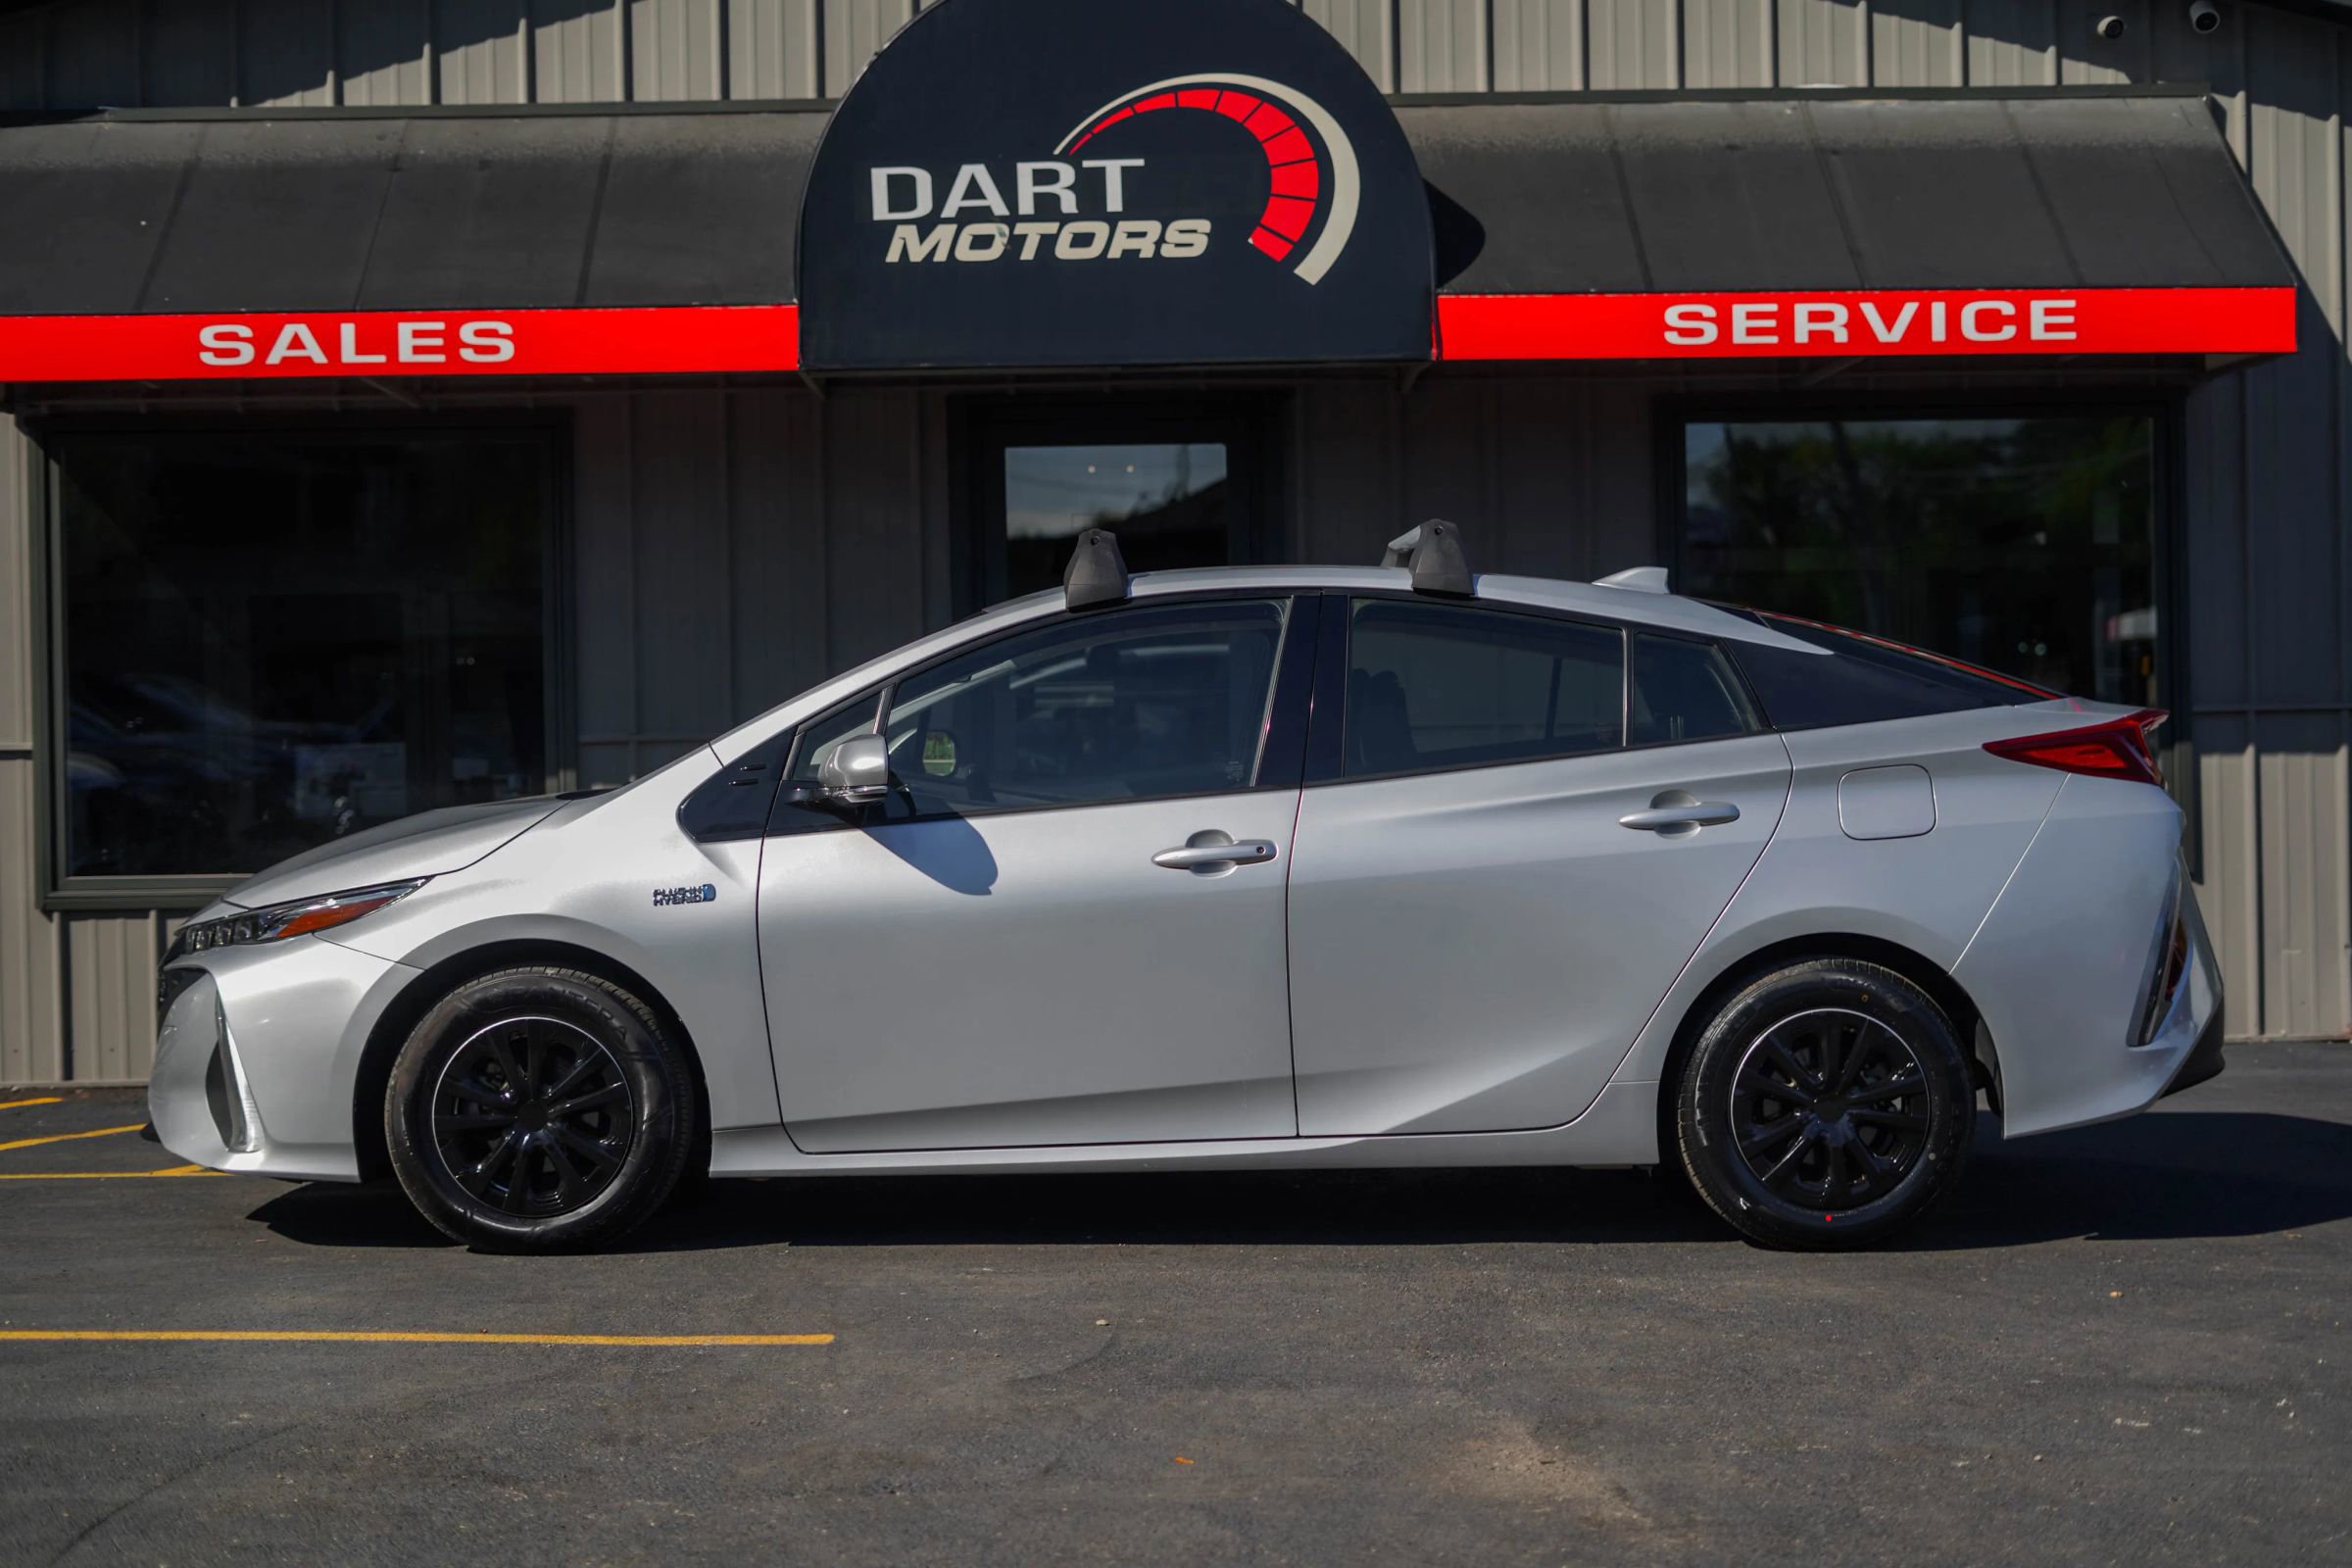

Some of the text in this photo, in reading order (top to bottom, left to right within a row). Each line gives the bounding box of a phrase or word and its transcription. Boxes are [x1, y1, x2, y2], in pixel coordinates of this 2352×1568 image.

[870, 159, 1145, 220] DART
[884, 219, 1211, 263] MOTORS
[198, 320, 515, 367] SALES
[1663, 299, 2078, 346] SERVICE
